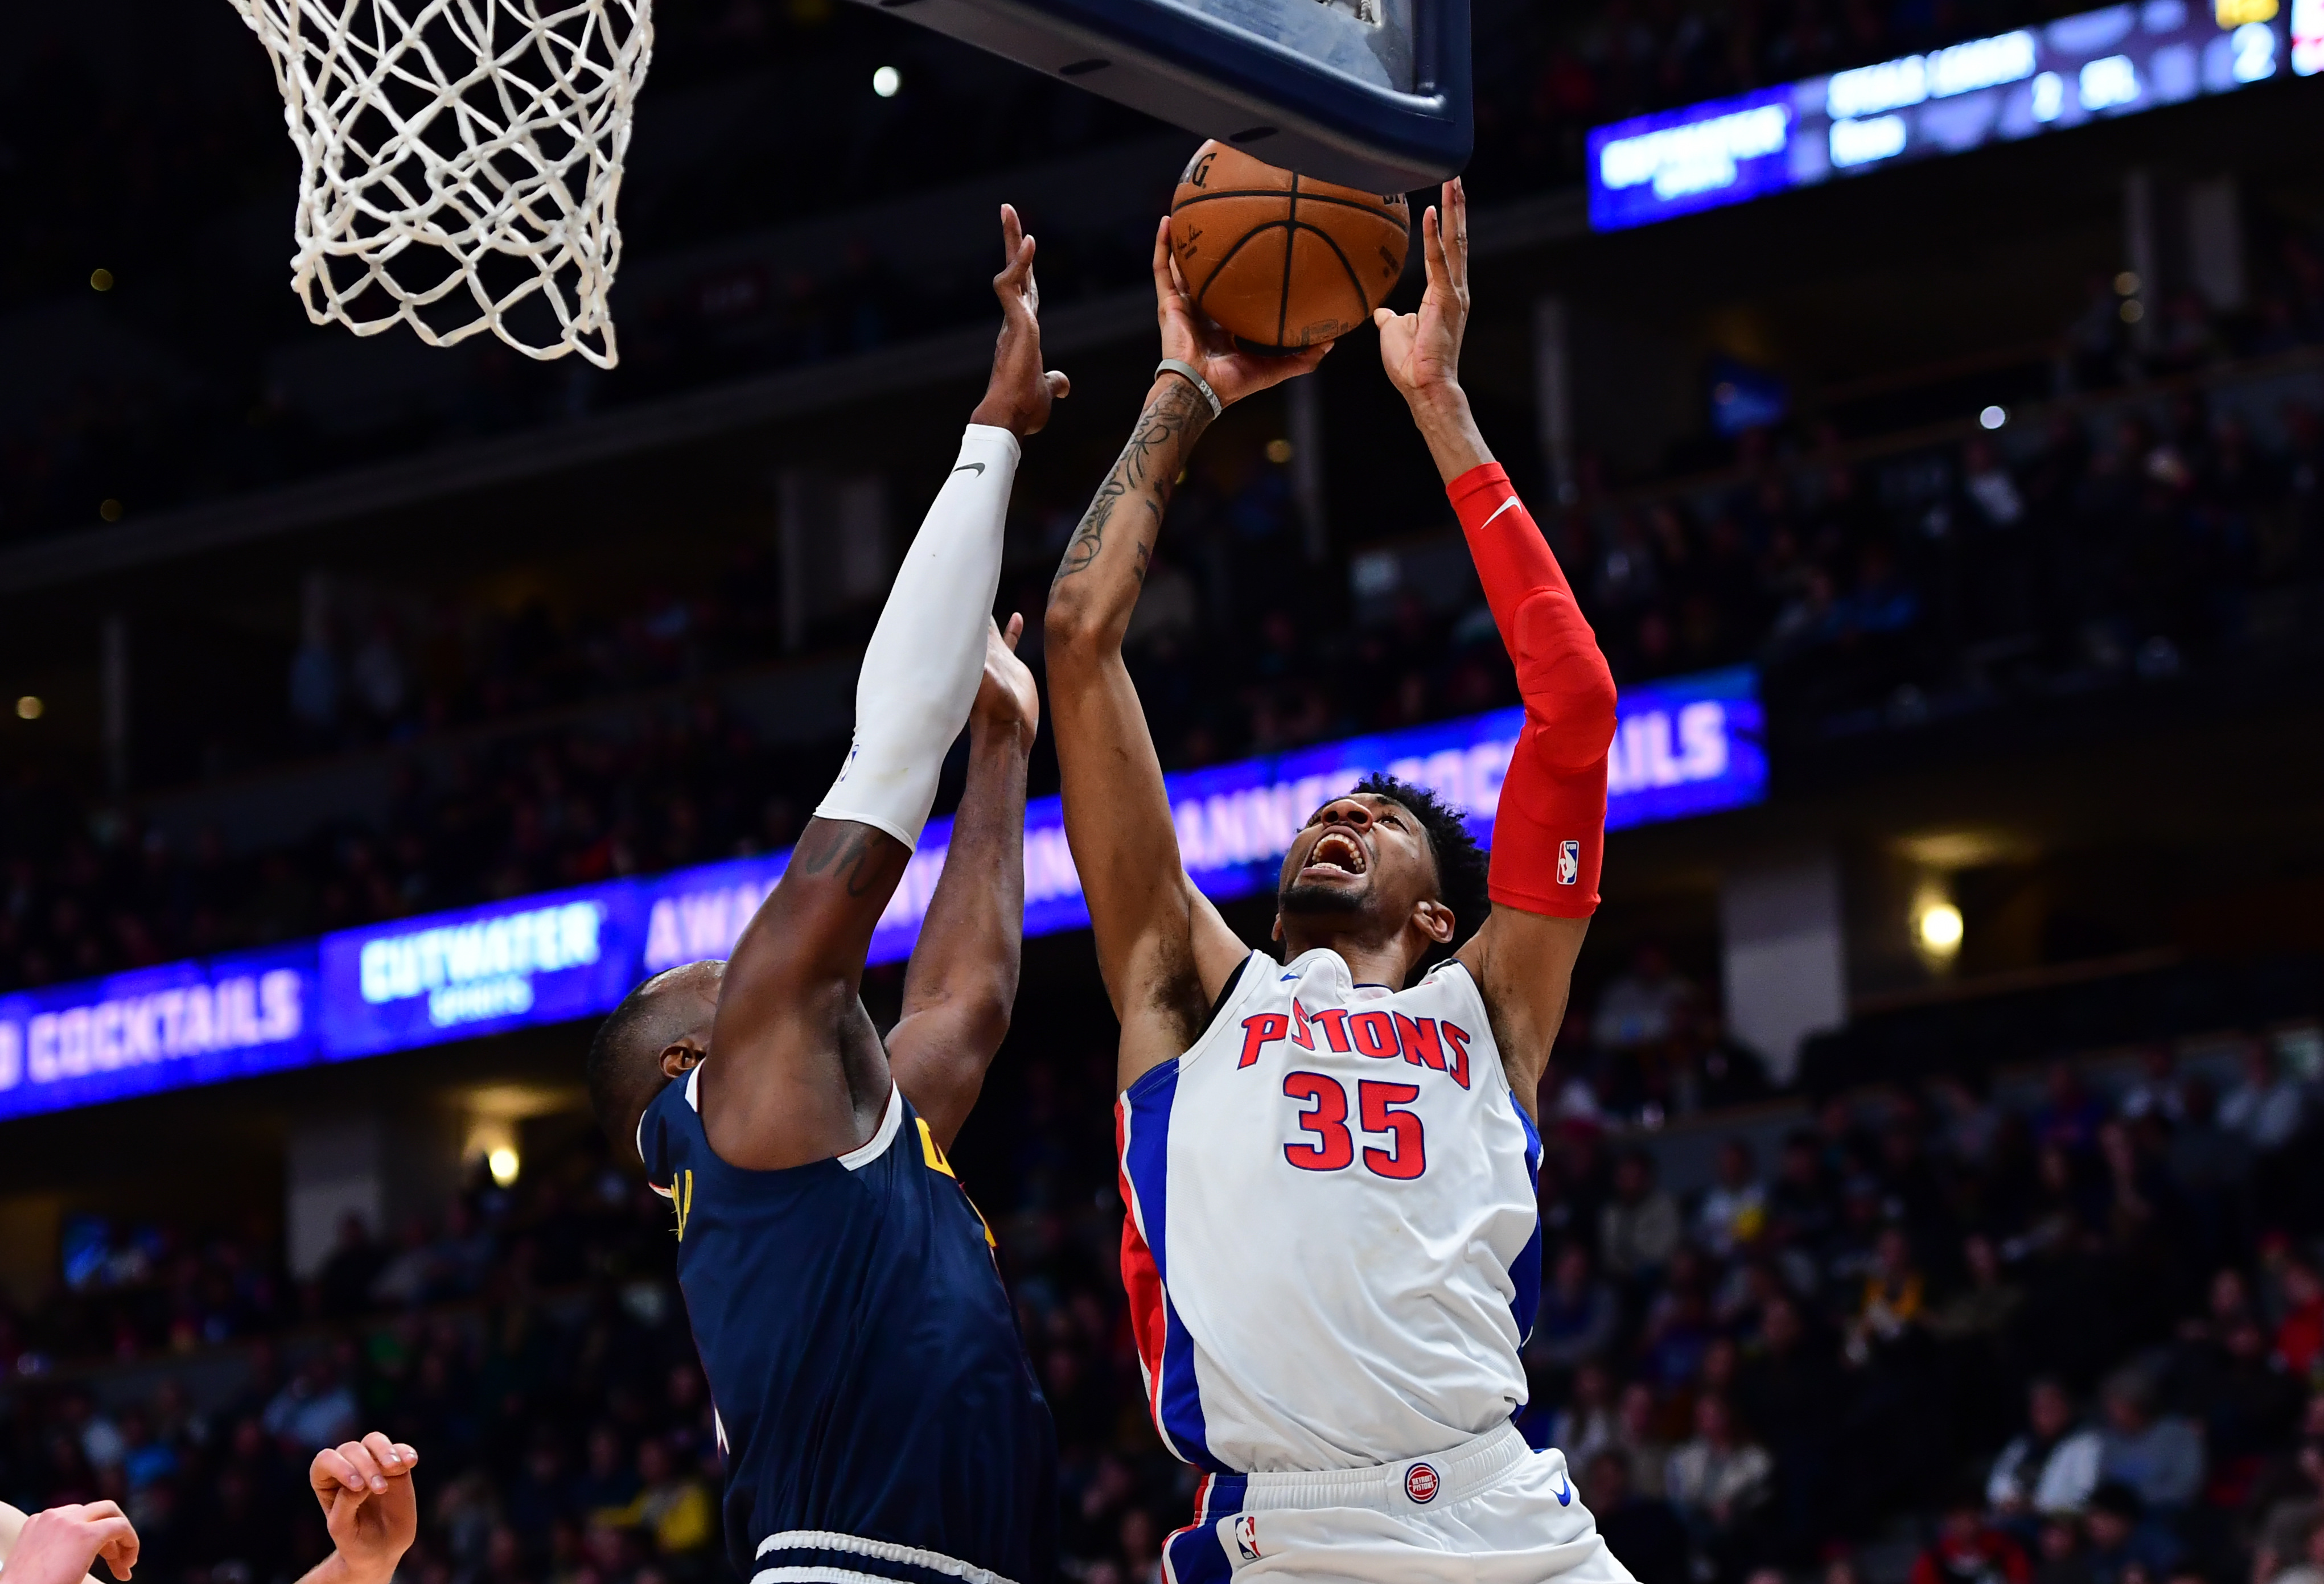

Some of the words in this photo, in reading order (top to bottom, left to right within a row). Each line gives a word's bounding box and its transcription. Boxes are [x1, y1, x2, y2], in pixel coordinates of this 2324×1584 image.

[360, 901, 602, 1003] CUTWATER
[27, 968, 302, 1083] COCKTAILS
[1237, 997, 1471, 1091] PSTONS
[1283, 1071, 1426, 1180] 35
[1412, 1475, 1433, 1485] DETROIT
[1413, 1482, 1434, 1492] PISTONS
